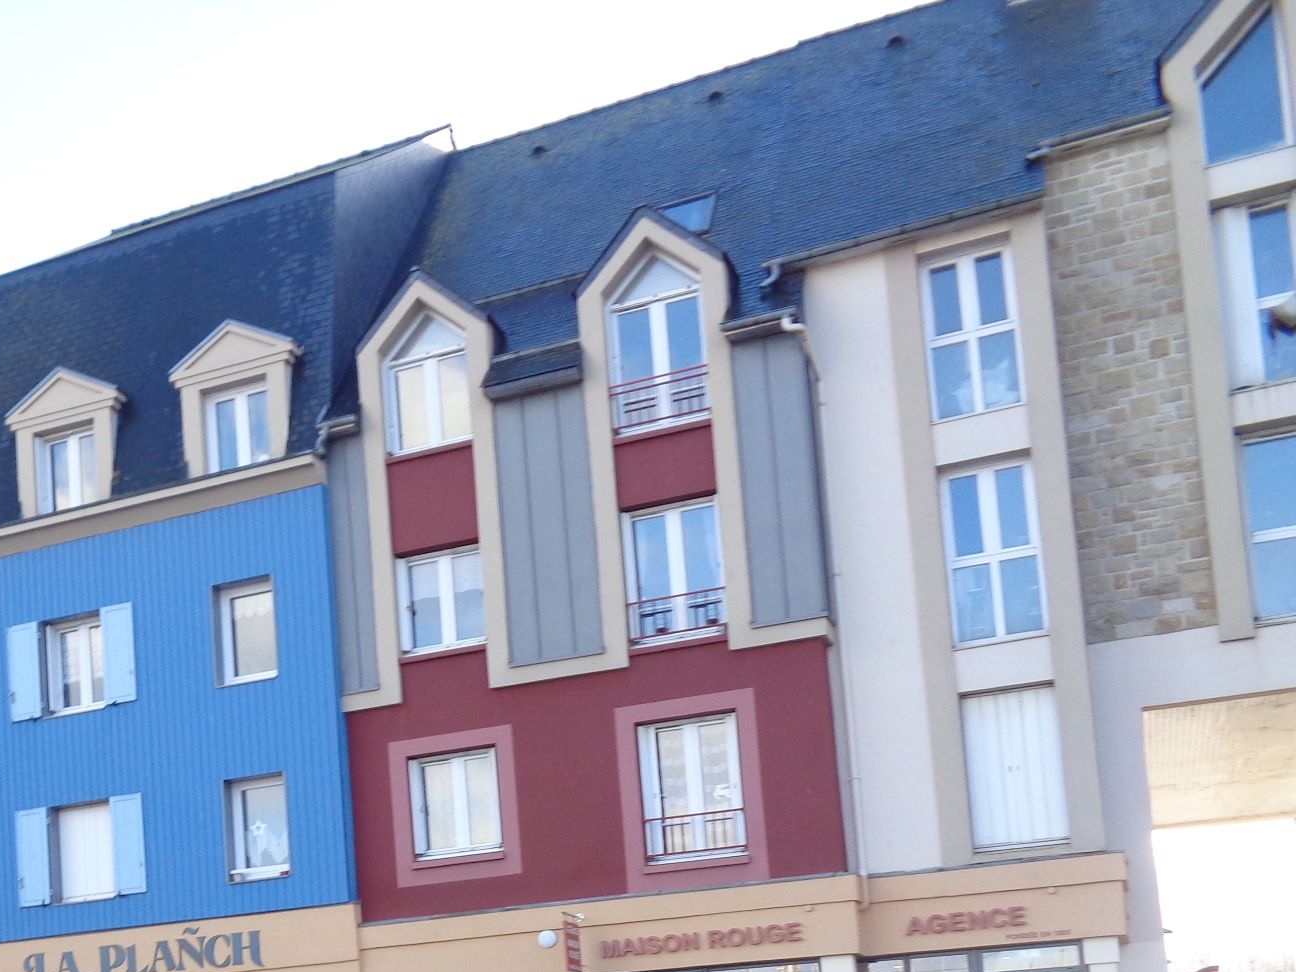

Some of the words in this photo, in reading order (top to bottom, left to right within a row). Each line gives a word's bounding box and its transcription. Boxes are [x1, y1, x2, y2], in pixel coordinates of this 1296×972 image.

[905, 905, 1027, 936] AGENCE
[600, 931, 700, 959] MAISON
[707, 921, 804, 949] ROUGE
